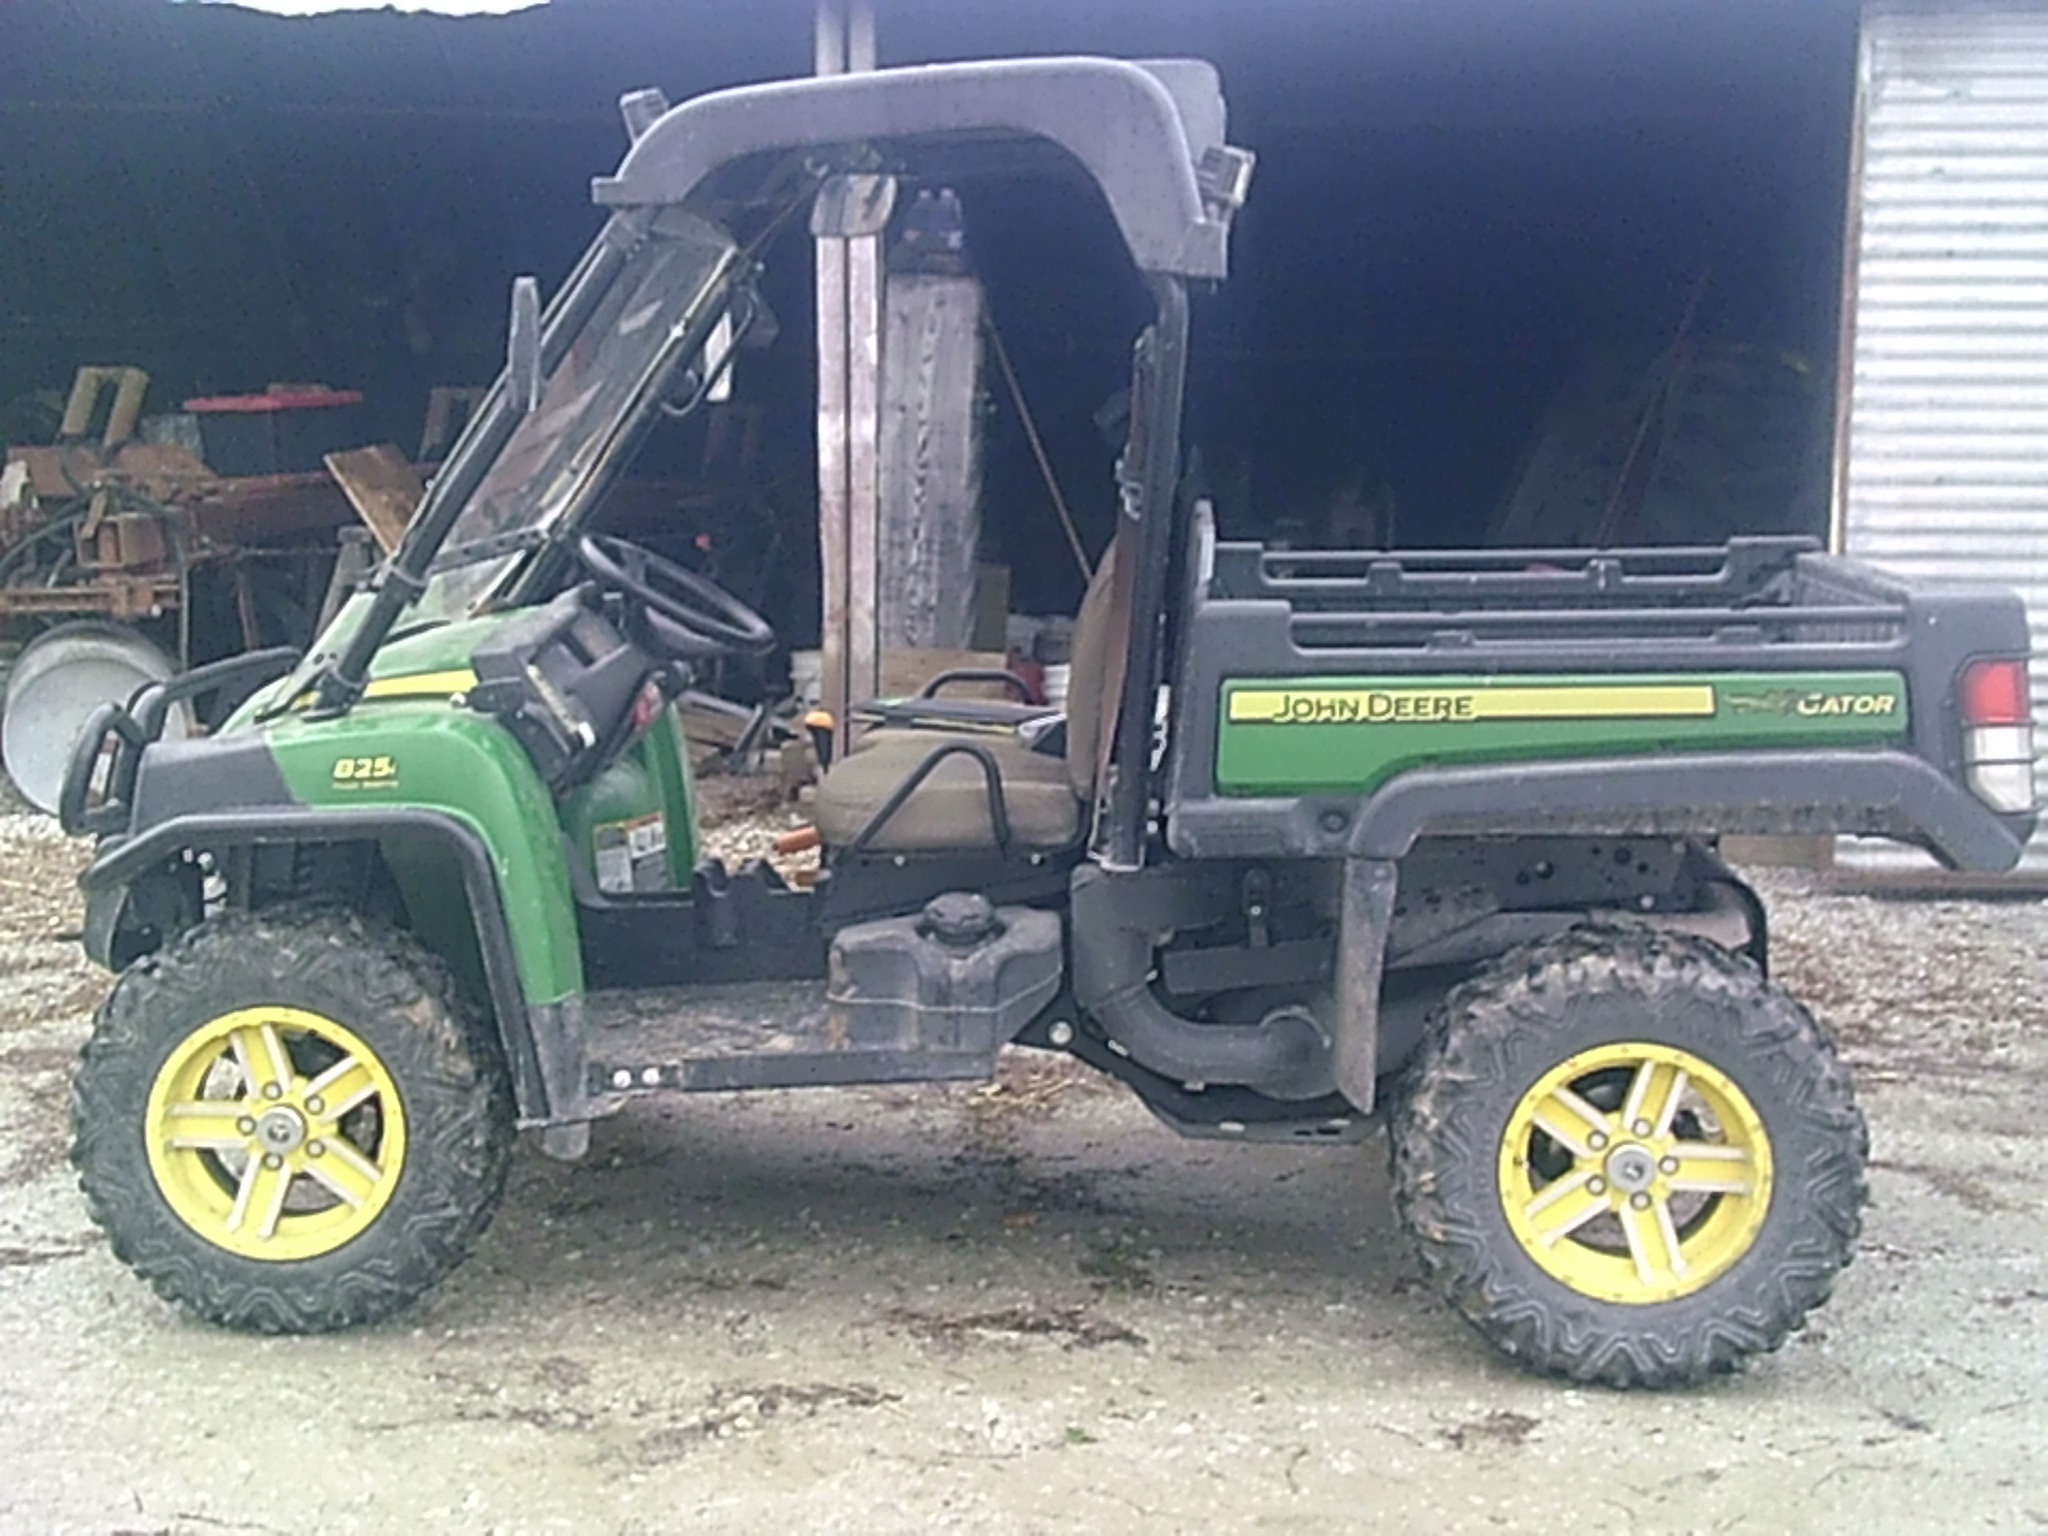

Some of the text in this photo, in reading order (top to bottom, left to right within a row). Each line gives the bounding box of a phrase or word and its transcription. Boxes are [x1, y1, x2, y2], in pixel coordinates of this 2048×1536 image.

[1275, 694, 1474, 718] JOHN DEERE
[1797, 692, 1895, 715] GATOR
